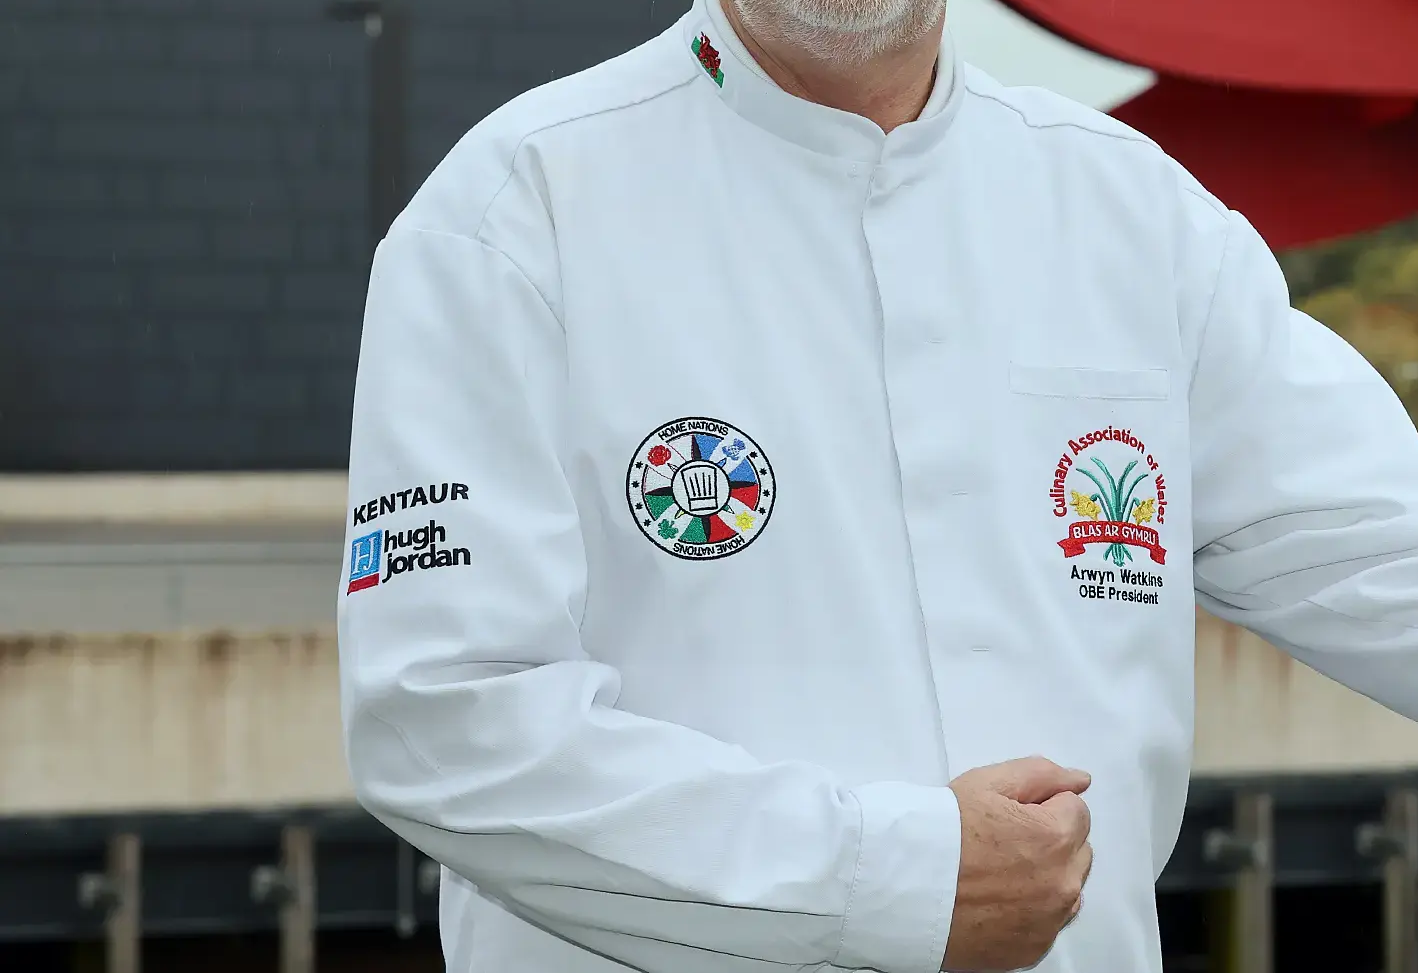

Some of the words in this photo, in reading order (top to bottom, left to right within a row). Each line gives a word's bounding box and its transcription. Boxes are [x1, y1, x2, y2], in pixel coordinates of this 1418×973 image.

[658, 422, 686, 440] HOME
[688, 421, 729, 436] NATIONS
[1049, 453, 1073, 517] Culinary
[1067, 426, 1145, 455] Association
[1146, 454, 1159, 471] of
[1155, 474, 1167, 524] Wales
[353, 483, 469, 527] KENTAUR
[384, 520, 446, 552] hugh
[717, 535, 745, 554] HOME
[1073, 525, 1102, 539] BLAS
[1104, 525, 1119, 537] AR
[1122, 527, 1156, 545] GYMRU
[673, 543, 715, 557] NATIONS
[382, 544, 471, 583] jordan
[1071, 565, 1115, 585] Arwyn
[1120, 568, 1163, 587] Watkins
[1079, 585, 1105, 599] OBE
[1108, 586, 1158, 604] President
